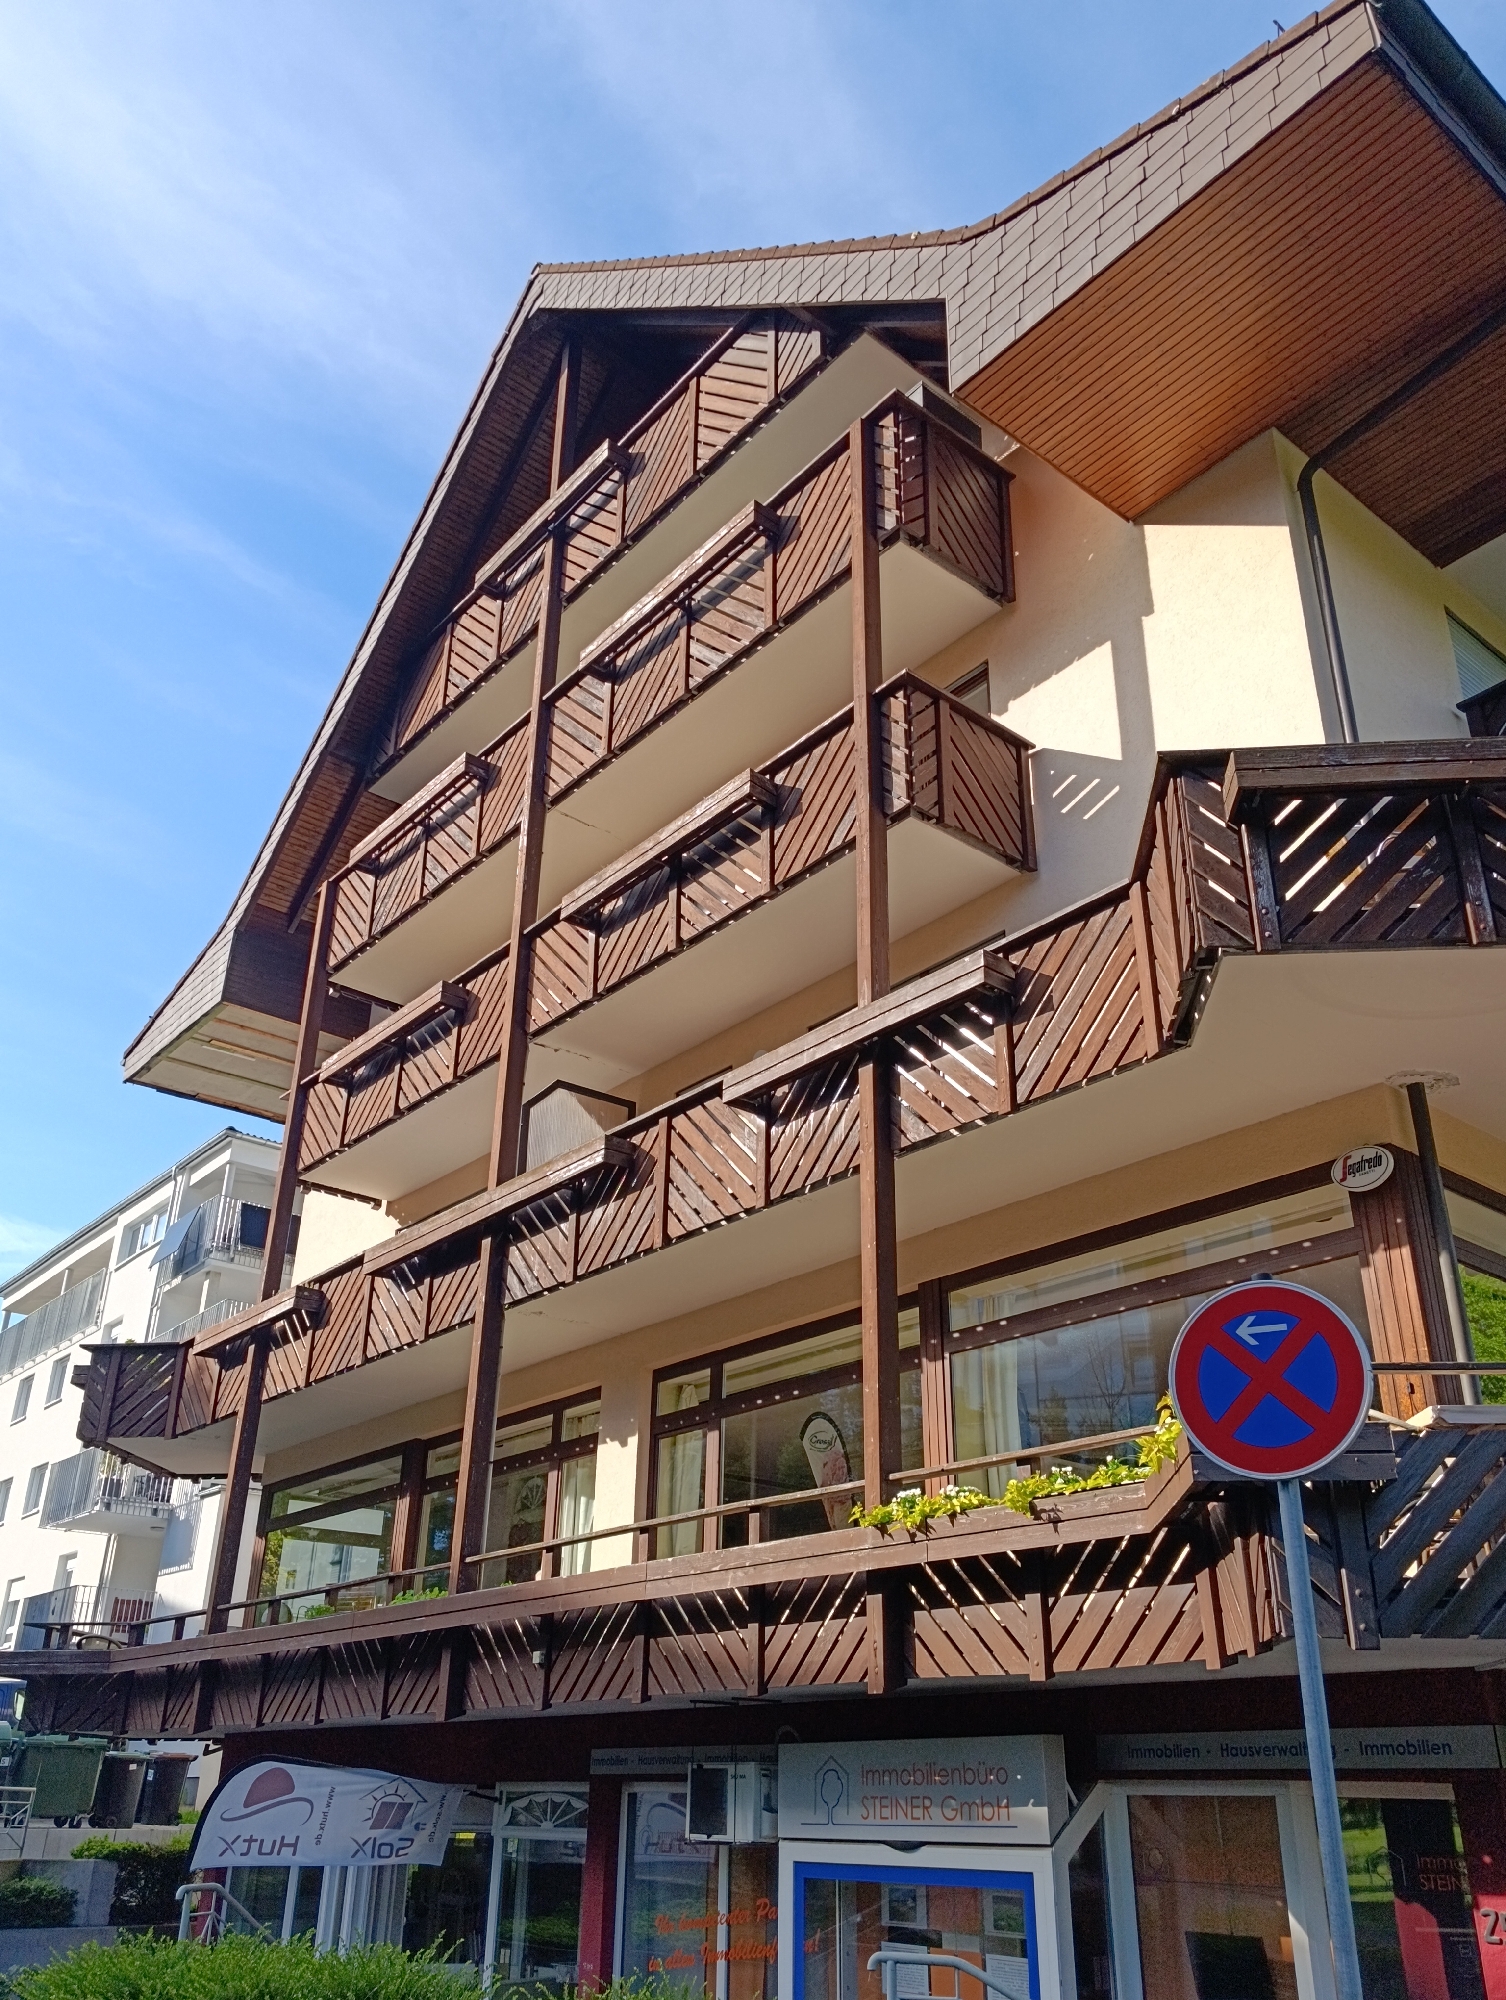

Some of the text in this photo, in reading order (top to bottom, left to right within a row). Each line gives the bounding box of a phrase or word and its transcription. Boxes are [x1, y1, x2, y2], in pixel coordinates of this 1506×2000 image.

[1340, 1151, 1382, 1183] Segafredo
[592, 1754, 628, 1766] Immobilien
[1127, 1744, 1200, 1759] Immobilien
[1220, 1742, 1336, 1761] Hausverwaltg
[1359, 1740, 1453, 1757] Immobilien
[860, 1761, 1009, 1786] Immobilienbüro
[860, 1795, 1011, 1822] STEINER GmbH
